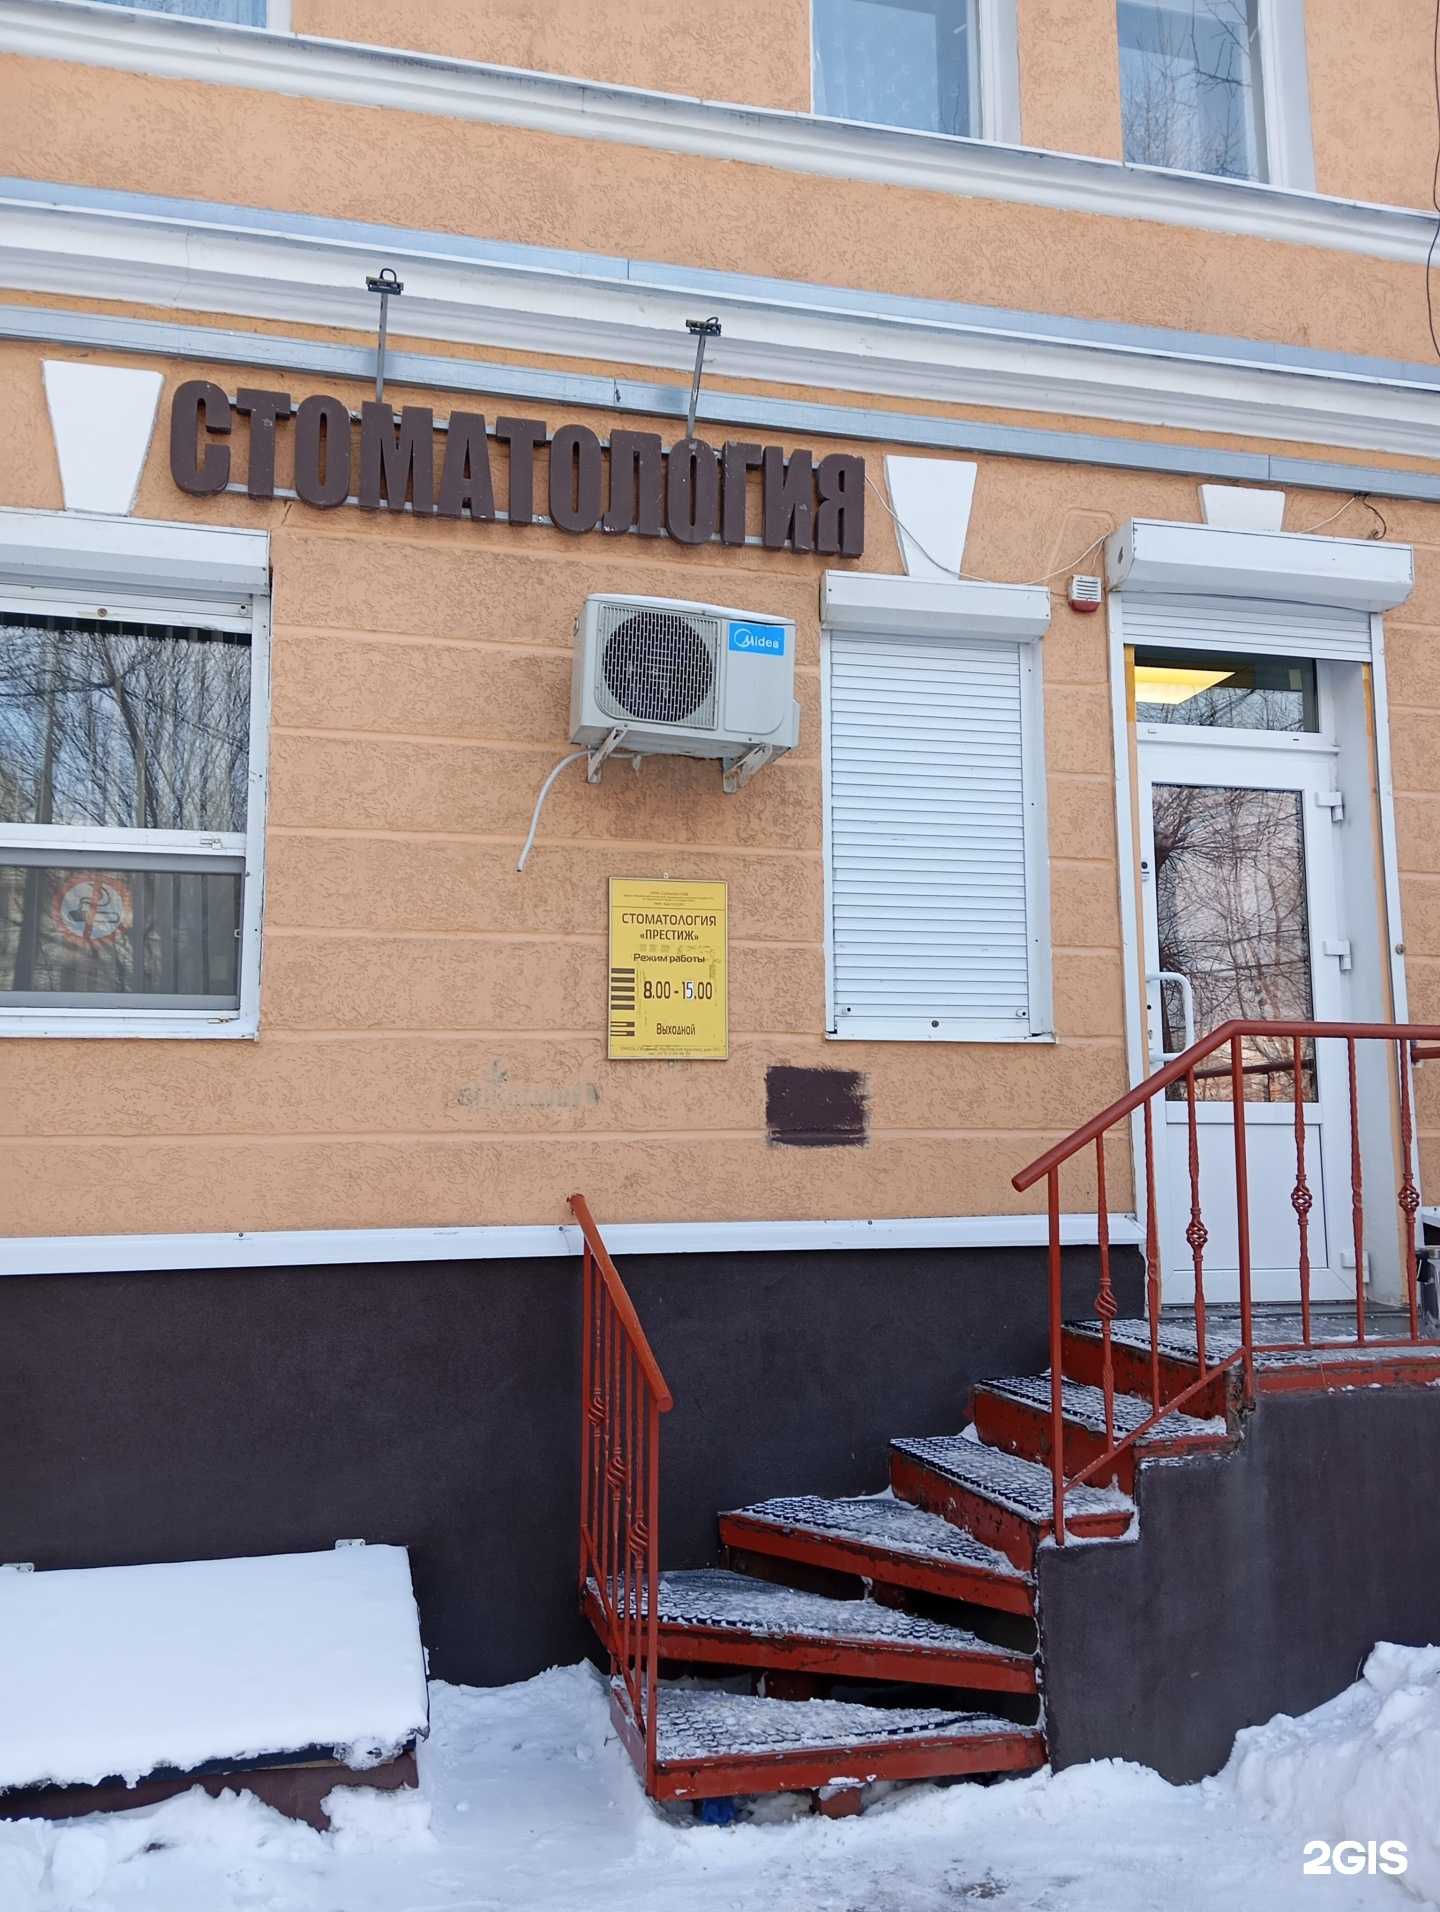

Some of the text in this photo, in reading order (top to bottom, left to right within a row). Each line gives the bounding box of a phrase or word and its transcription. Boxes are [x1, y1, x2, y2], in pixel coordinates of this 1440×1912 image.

[170, 379, 866, 559] СТОМАТОЛОГИЯ
[737, 630, 780, 649] Midea
[621, 913, 717, 926] СТОМАТОЛОГИЯ
[640, 929, 699, 940] «ПРЕСТИЖ»
[633, 953, 705, 963] Режим работы
[643, 980, 671, 999] 8.00
[682, 981, 713, 1000] 15.00
[656, 1023, 696, 1036] Выходной
